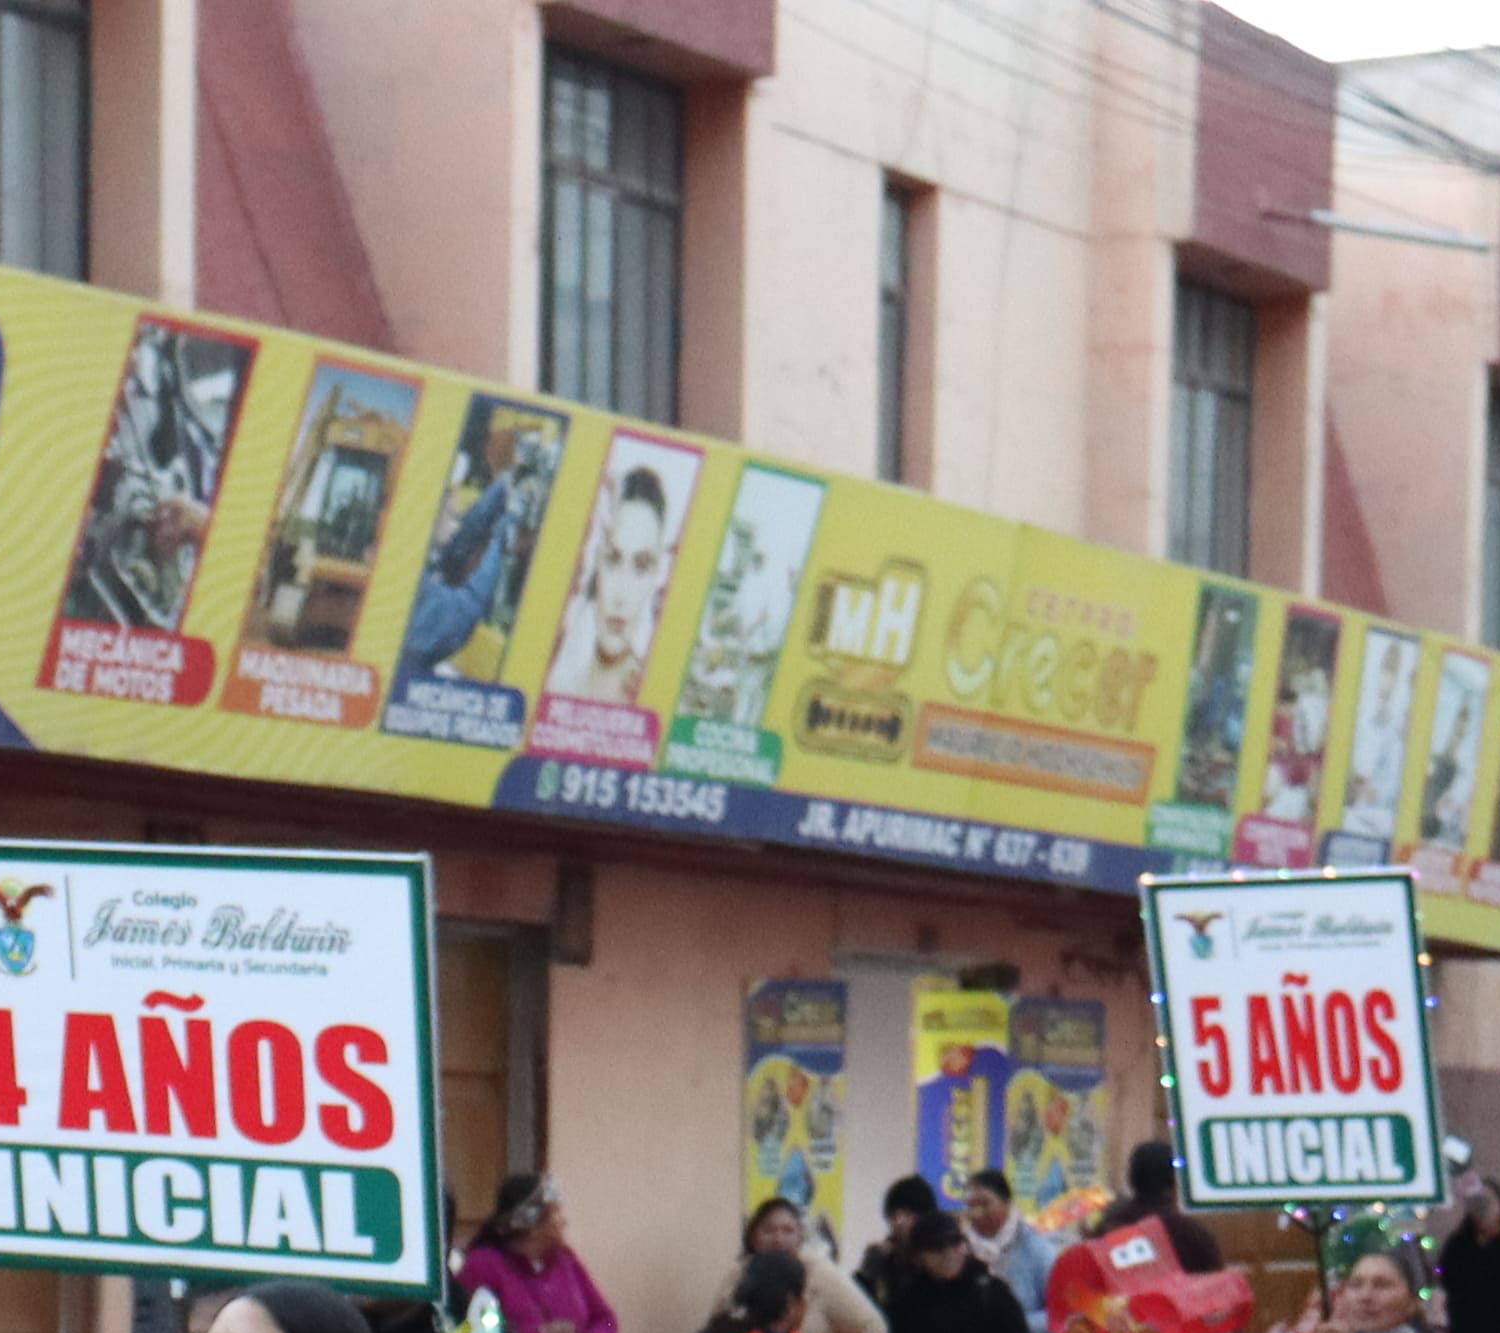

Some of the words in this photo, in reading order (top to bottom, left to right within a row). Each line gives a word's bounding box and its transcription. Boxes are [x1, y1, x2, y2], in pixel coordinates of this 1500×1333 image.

[826, 576, 922, 666] MH
[54, 658, 90, 691] DE
[92, 663, 175, 704] MOTOS
[237, 648, 372, 697] MAQUINARIA
[944, 574, 1159, 734] Crecer
[258, 682, 342, 723] PESADA
[561, 764, 620, 810] 915
[625, 773, 727, 823] 153545
[841, 806, 964, 859] APURIMAC
[83, 897, 192, 955] James
[199, 903, 354, 956] Baldwin
[131, 889, 198, 910] Colegio
[160, 956, 226, 976] Primaria
[242, 958, 329, 978] Secundaria
[1190, 994, 1233, 1099] 5
[1248, 971, 1404, 1098] AÑOS
[57, 988, 396, 1153] AÑOS
[1211, 1119, 1404, 1187] INICIAL
